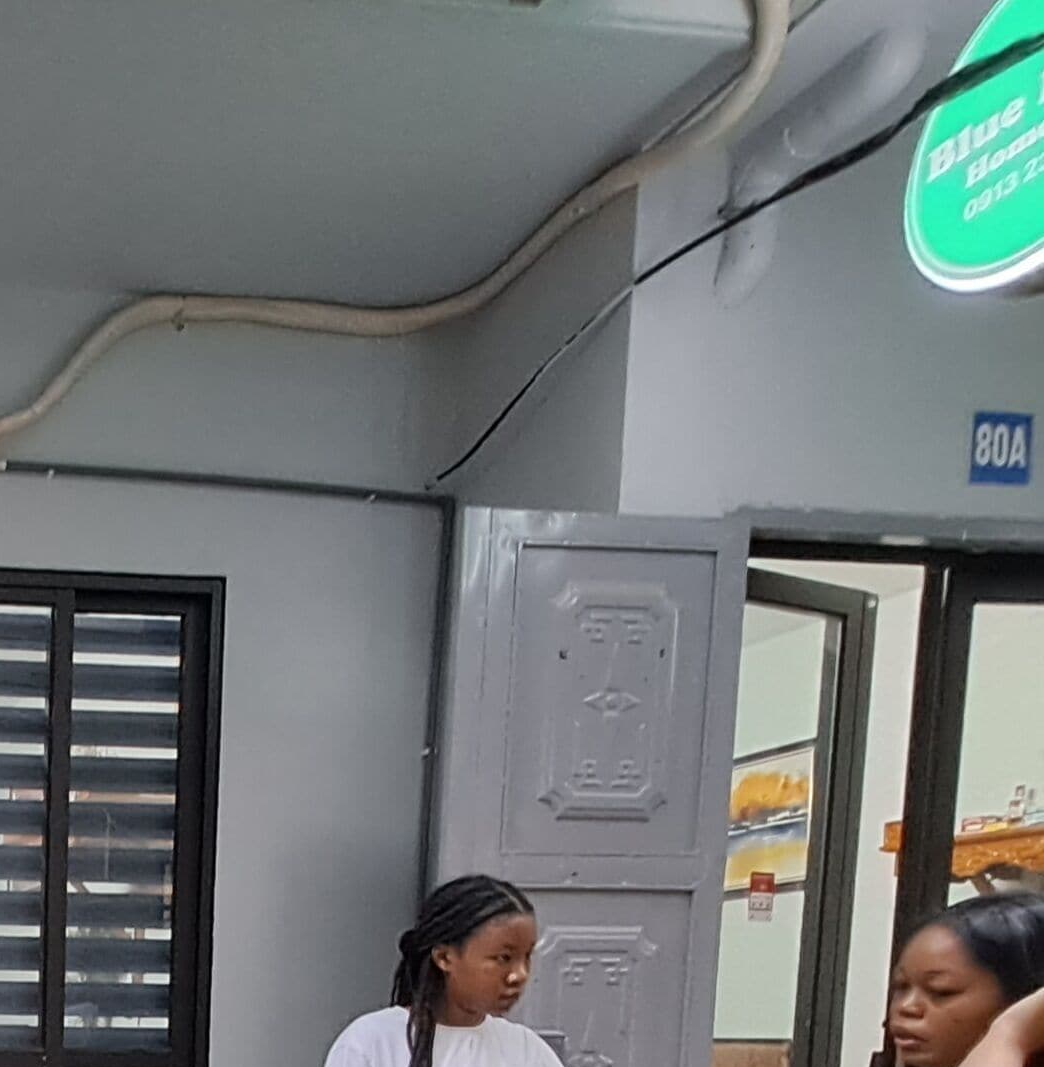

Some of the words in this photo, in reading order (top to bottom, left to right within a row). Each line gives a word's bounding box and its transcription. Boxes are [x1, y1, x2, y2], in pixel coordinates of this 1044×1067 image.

[927, 97, 1026, 183] Blue
[963, 171, 1019, 221] 0913
[976, 423, 1026, 468] 80A
